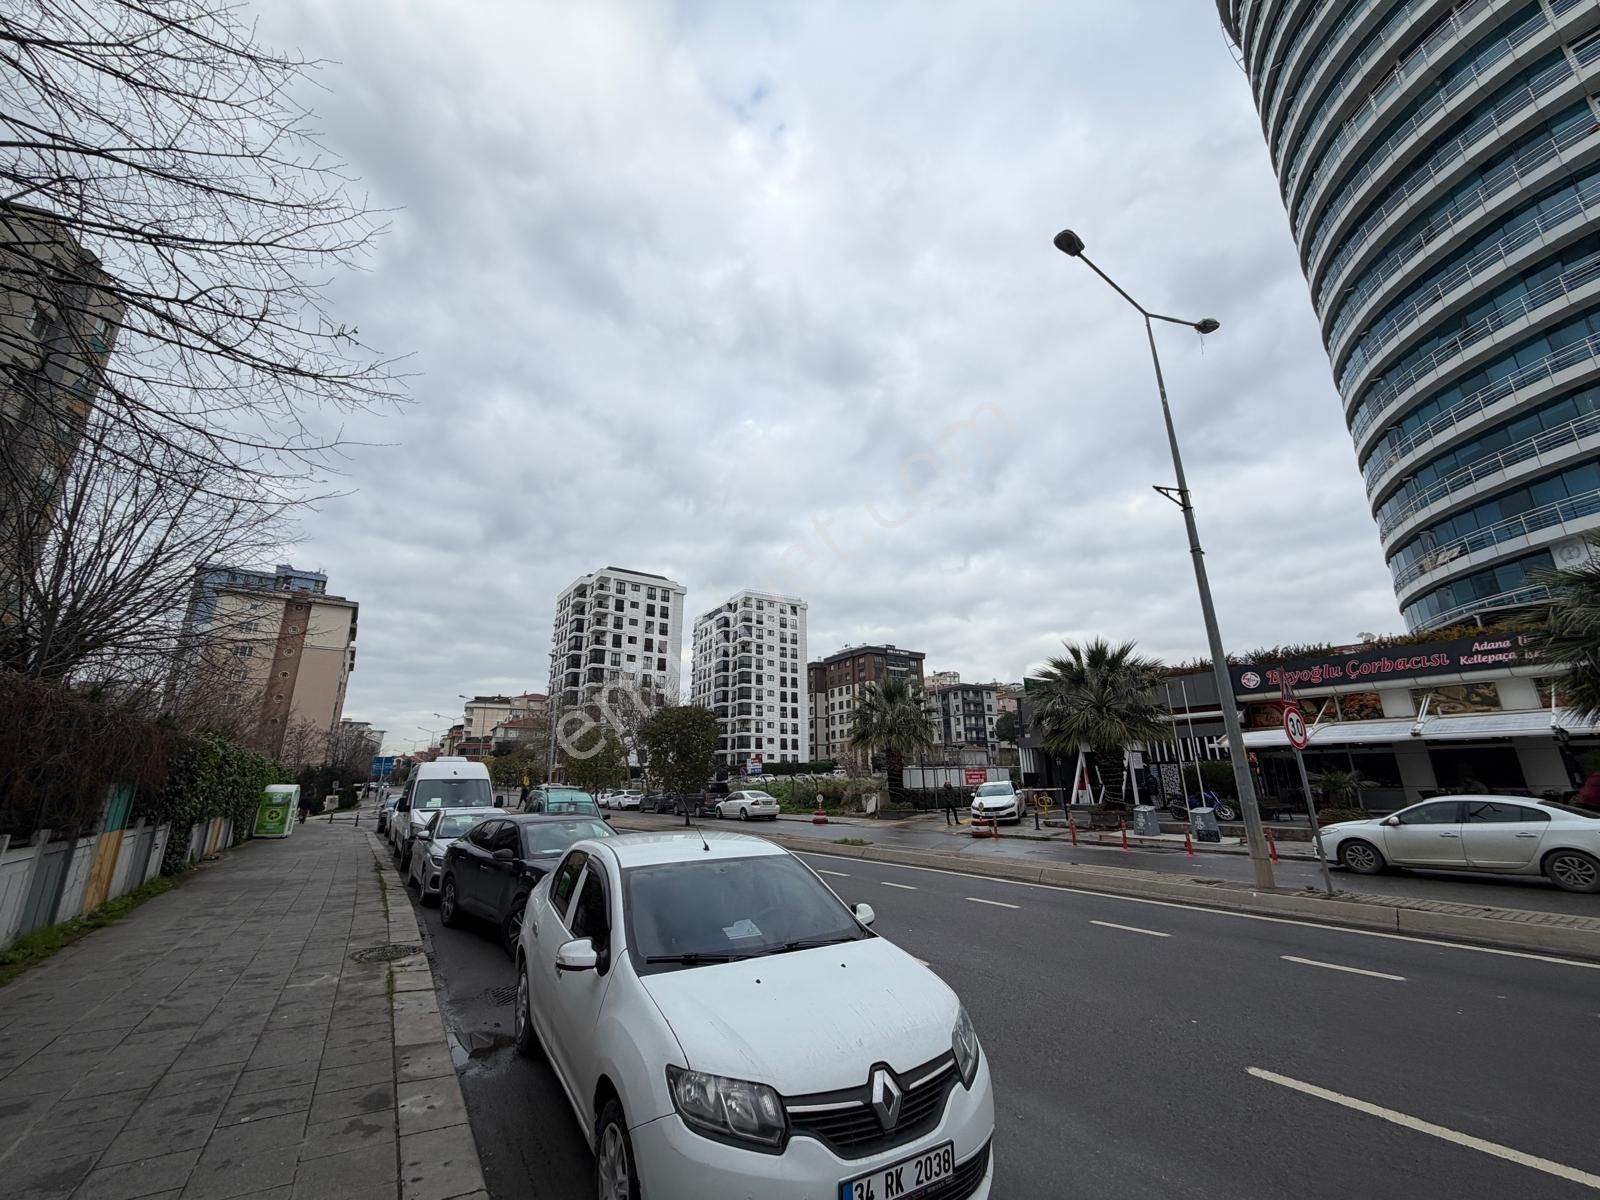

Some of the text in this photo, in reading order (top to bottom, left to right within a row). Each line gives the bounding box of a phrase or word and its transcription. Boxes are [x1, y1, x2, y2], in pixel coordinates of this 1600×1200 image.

[1472, 639, 1512, 652] Adana
[1346, 652, 1450, 680] Çorbacısı
[1459, 651, 1518, 666] Kellepaça
[1289, 717, 1304, 737] 30
[854, 1178, 875, 1200] 34
[885, 1167, 904, 1199] RK
[915, 1148, 951, 1186] 2038
